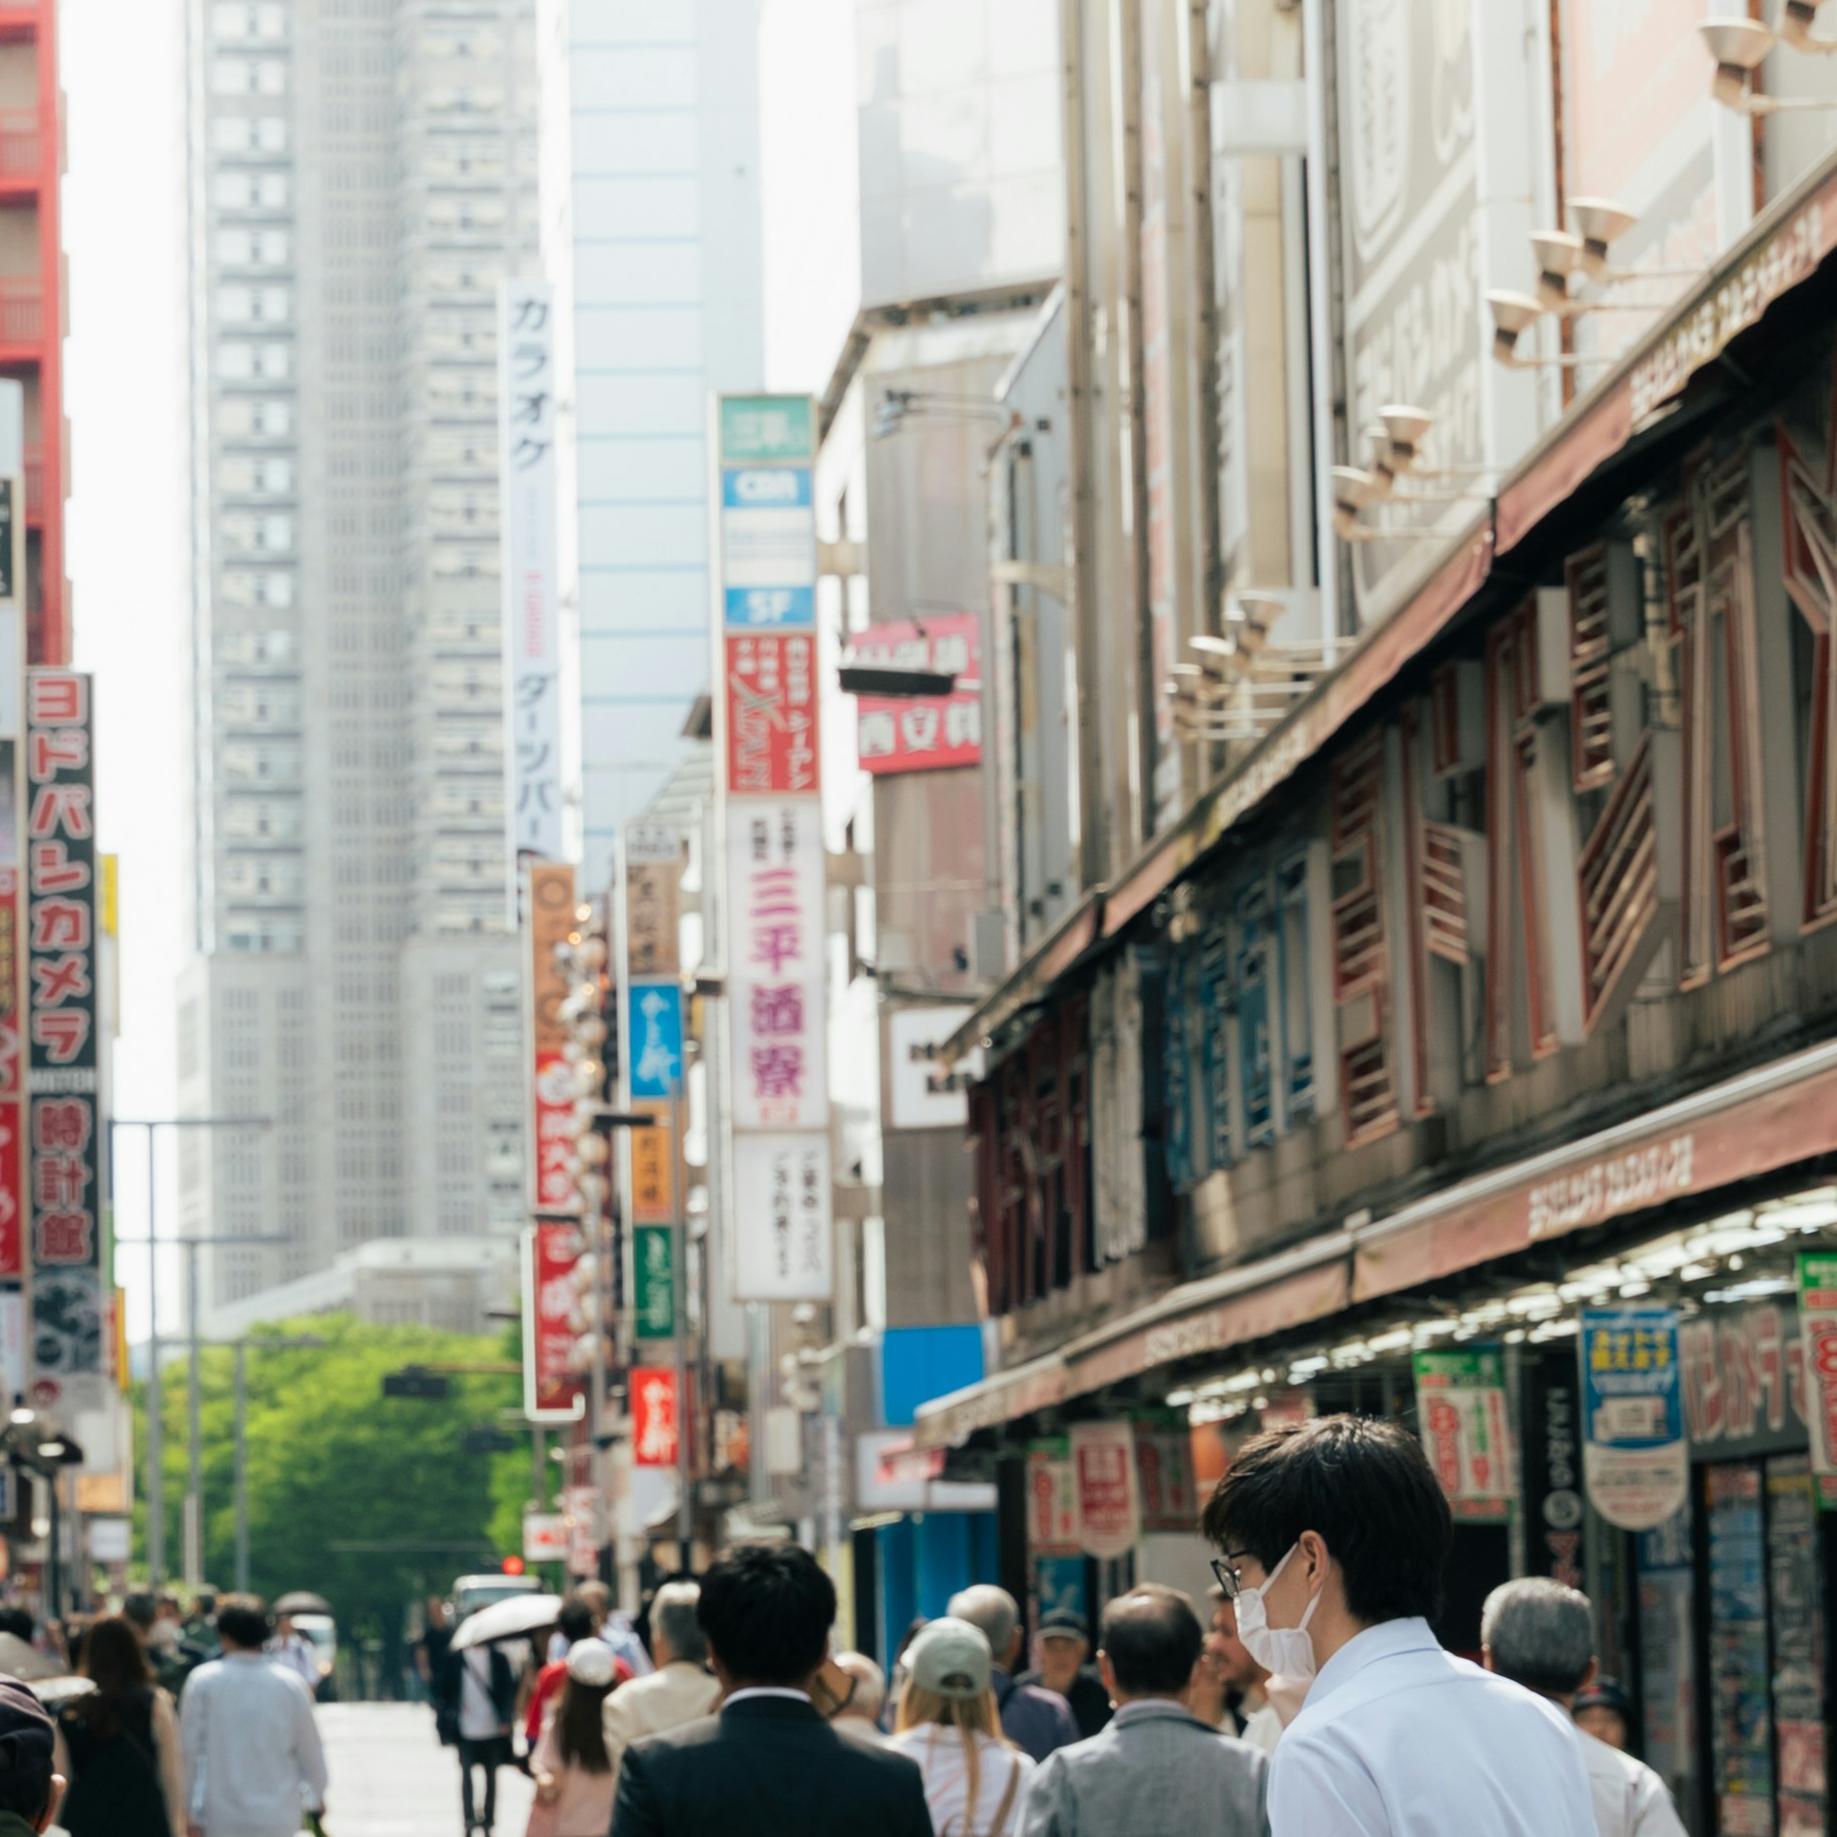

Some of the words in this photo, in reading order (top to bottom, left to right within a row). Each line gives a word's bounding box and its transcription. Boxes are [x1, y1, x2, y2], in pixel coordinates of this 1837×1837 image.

[508, 297, 555, 475] カラオケ
[30, 674, 94, 1065] ヨドバシカメラ
